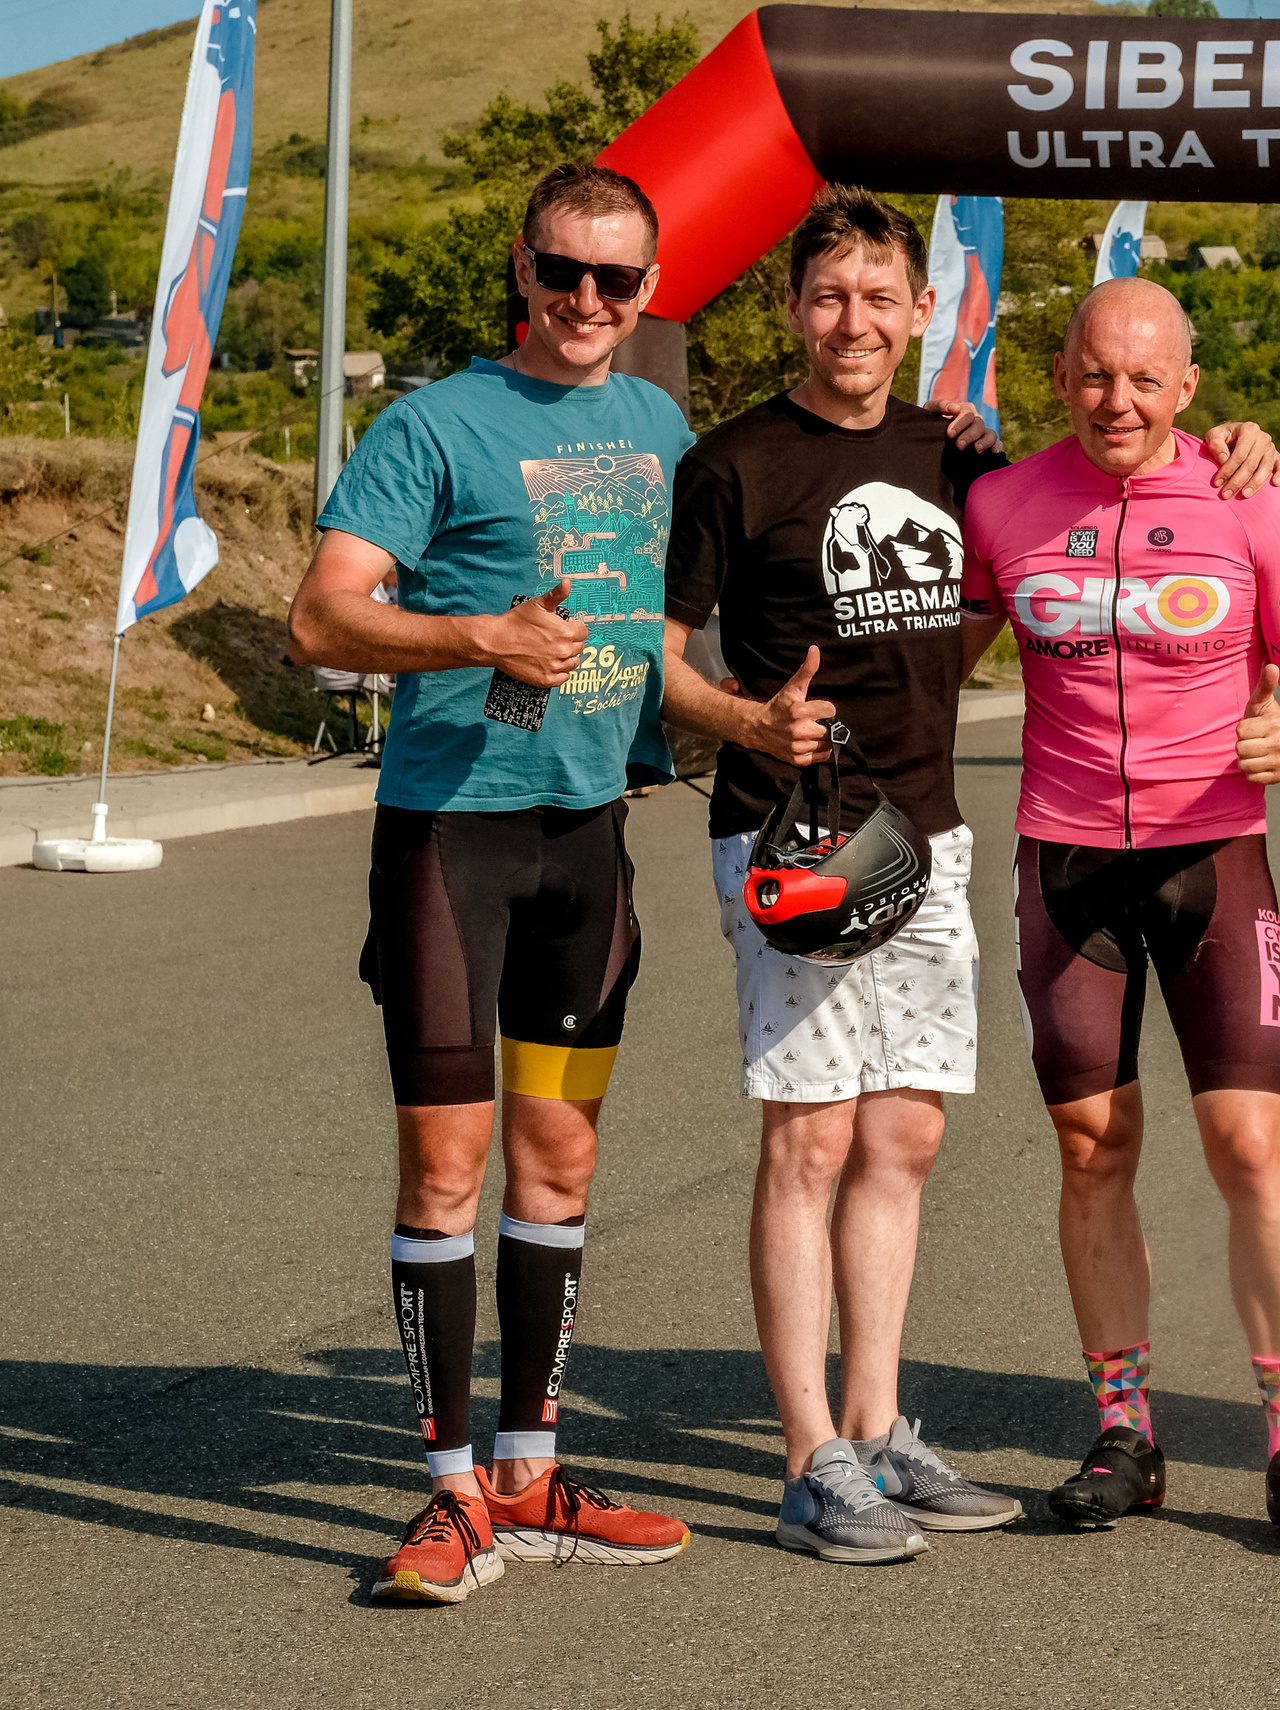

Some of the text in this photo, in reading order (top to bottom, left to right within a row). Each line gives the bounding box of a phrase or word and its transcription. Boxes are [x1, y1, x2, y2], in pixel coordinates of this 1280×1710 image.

[1007, 129, 1215, 168] ULTRA
[1068, 548, 1095, 557] NEED
[1070, 541, 1095, 549] YOU
[1080, 534, 1096, 542] ALL
[833, 584, 961, 621] SIBERMAN
[1014, 573, 1231, 637] GIRO
[837, 618, 898, 638] ULTRA
[1026, 636, 1226, 659] AMORE INFINITO
[583, 692, 622, 715] Sochi
[850, 874, 927, 916] PROJECT
[417, 1287, 425, 1324] TECHNOLOGY
[418, 1324, 429, 1365] COMPRESSION
